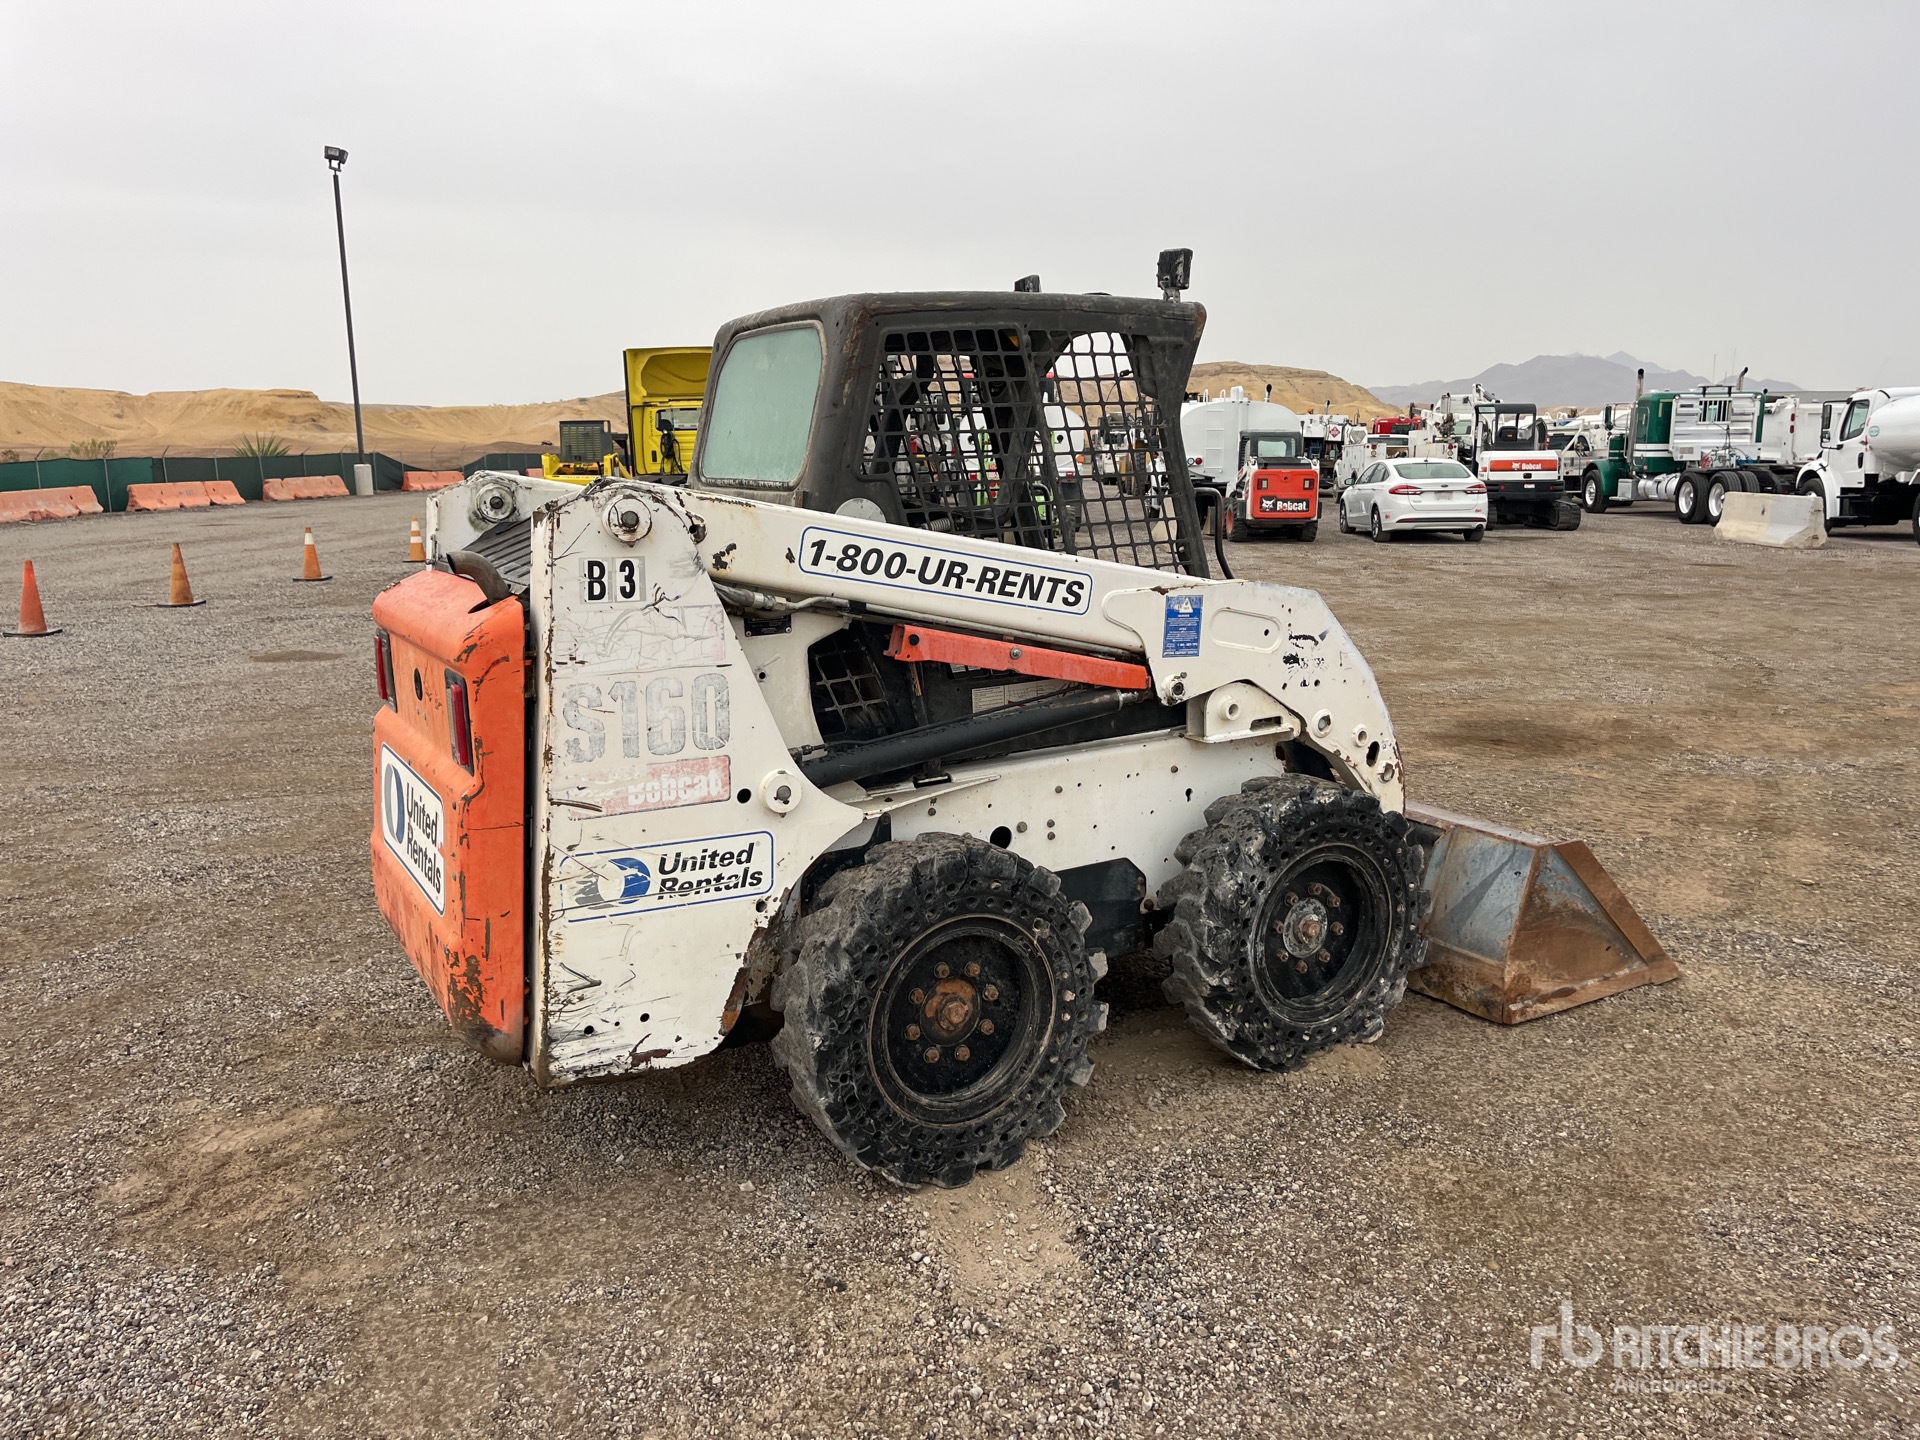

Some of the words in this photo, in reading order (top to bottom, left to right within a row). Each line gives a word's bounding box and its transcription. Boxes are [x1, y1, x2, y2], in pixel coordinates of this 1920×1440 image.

[1276, 501, 1308, 511] Bobcat
[587, 560, 606, 600] B
[618, 559, 636, 599] 3
[809, 539, 1085, 607] 1-800-UR-RENTS
[562, 672, 731, 763] S160
[406, 782, 439, 847] United
[406, 822, 442, 895] Rentals
[657, 866, 763, 900] Rentals
[658, 842, 755, 876] United
